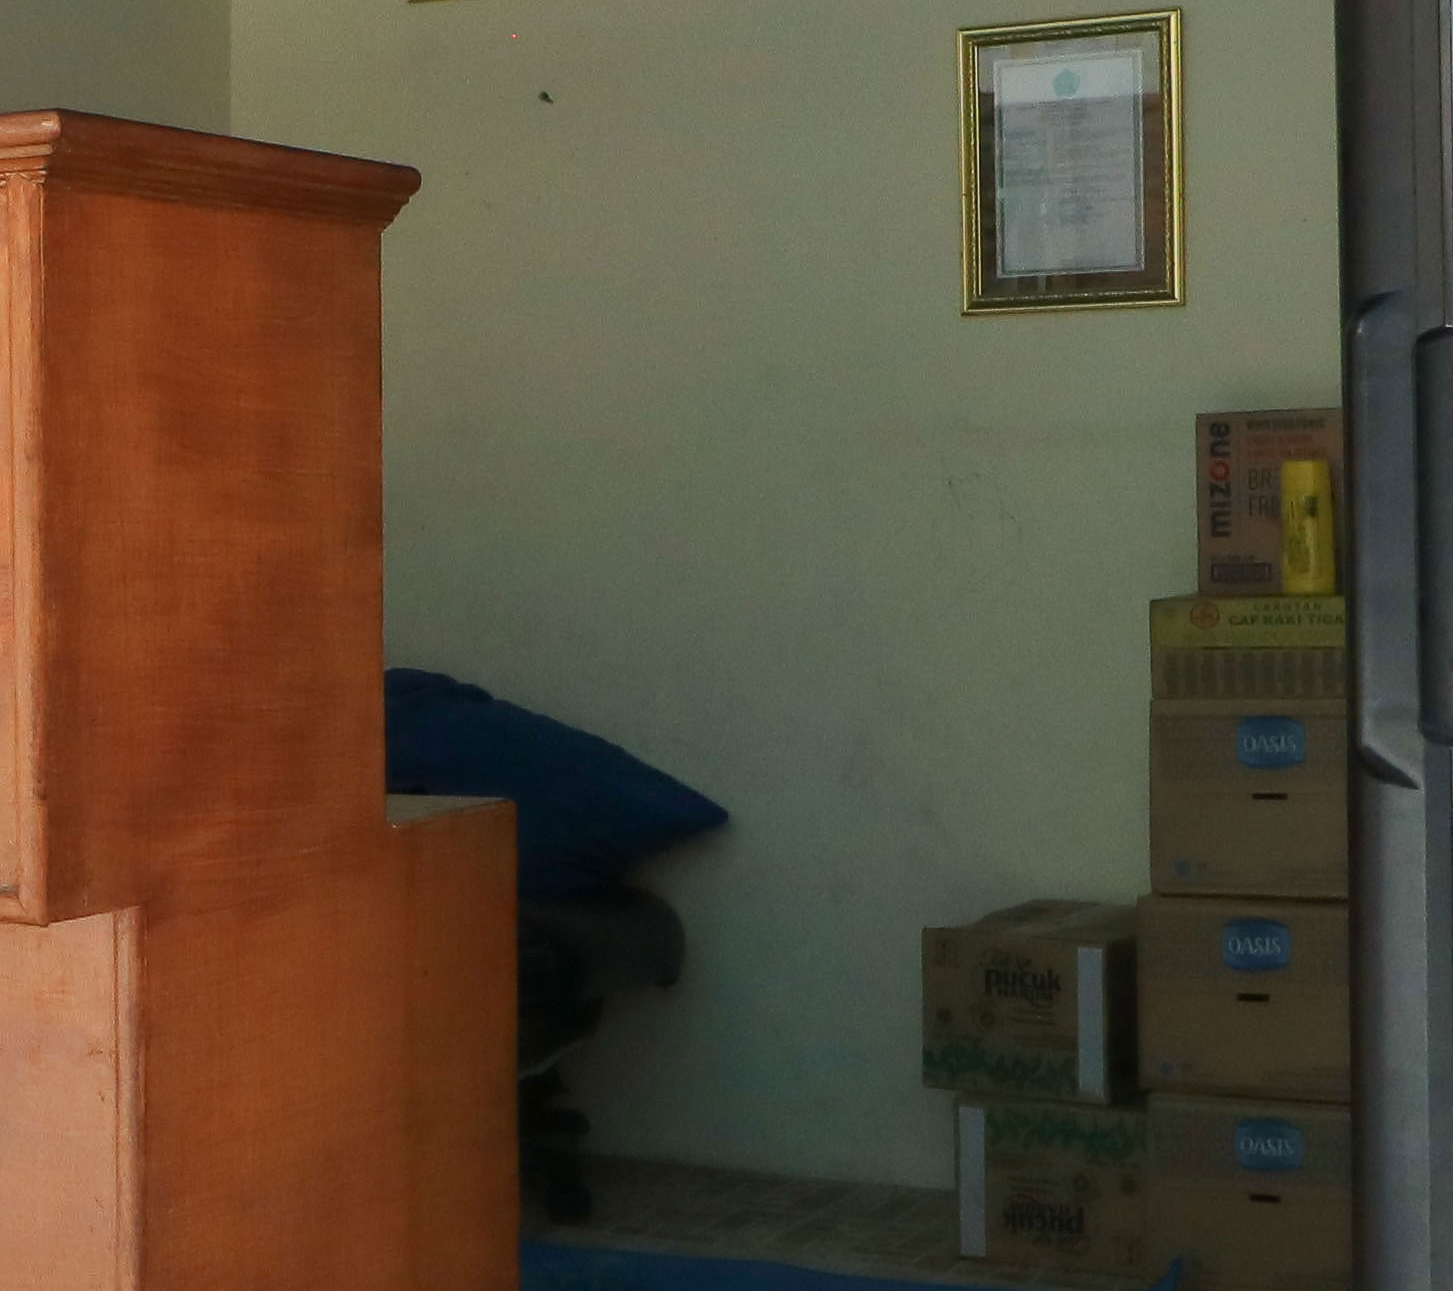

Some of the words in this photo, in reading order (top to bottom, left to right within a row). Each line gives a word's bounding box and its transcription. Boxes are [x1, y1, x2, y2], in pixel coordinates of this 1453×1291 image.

[1208, 421, 1232, 538] mizone
[1242, 733, 1297, 754] OASIS
[1228, 935, 1282, 956] OASIS
[1239, 1136, 1295, 1157] OASIS
